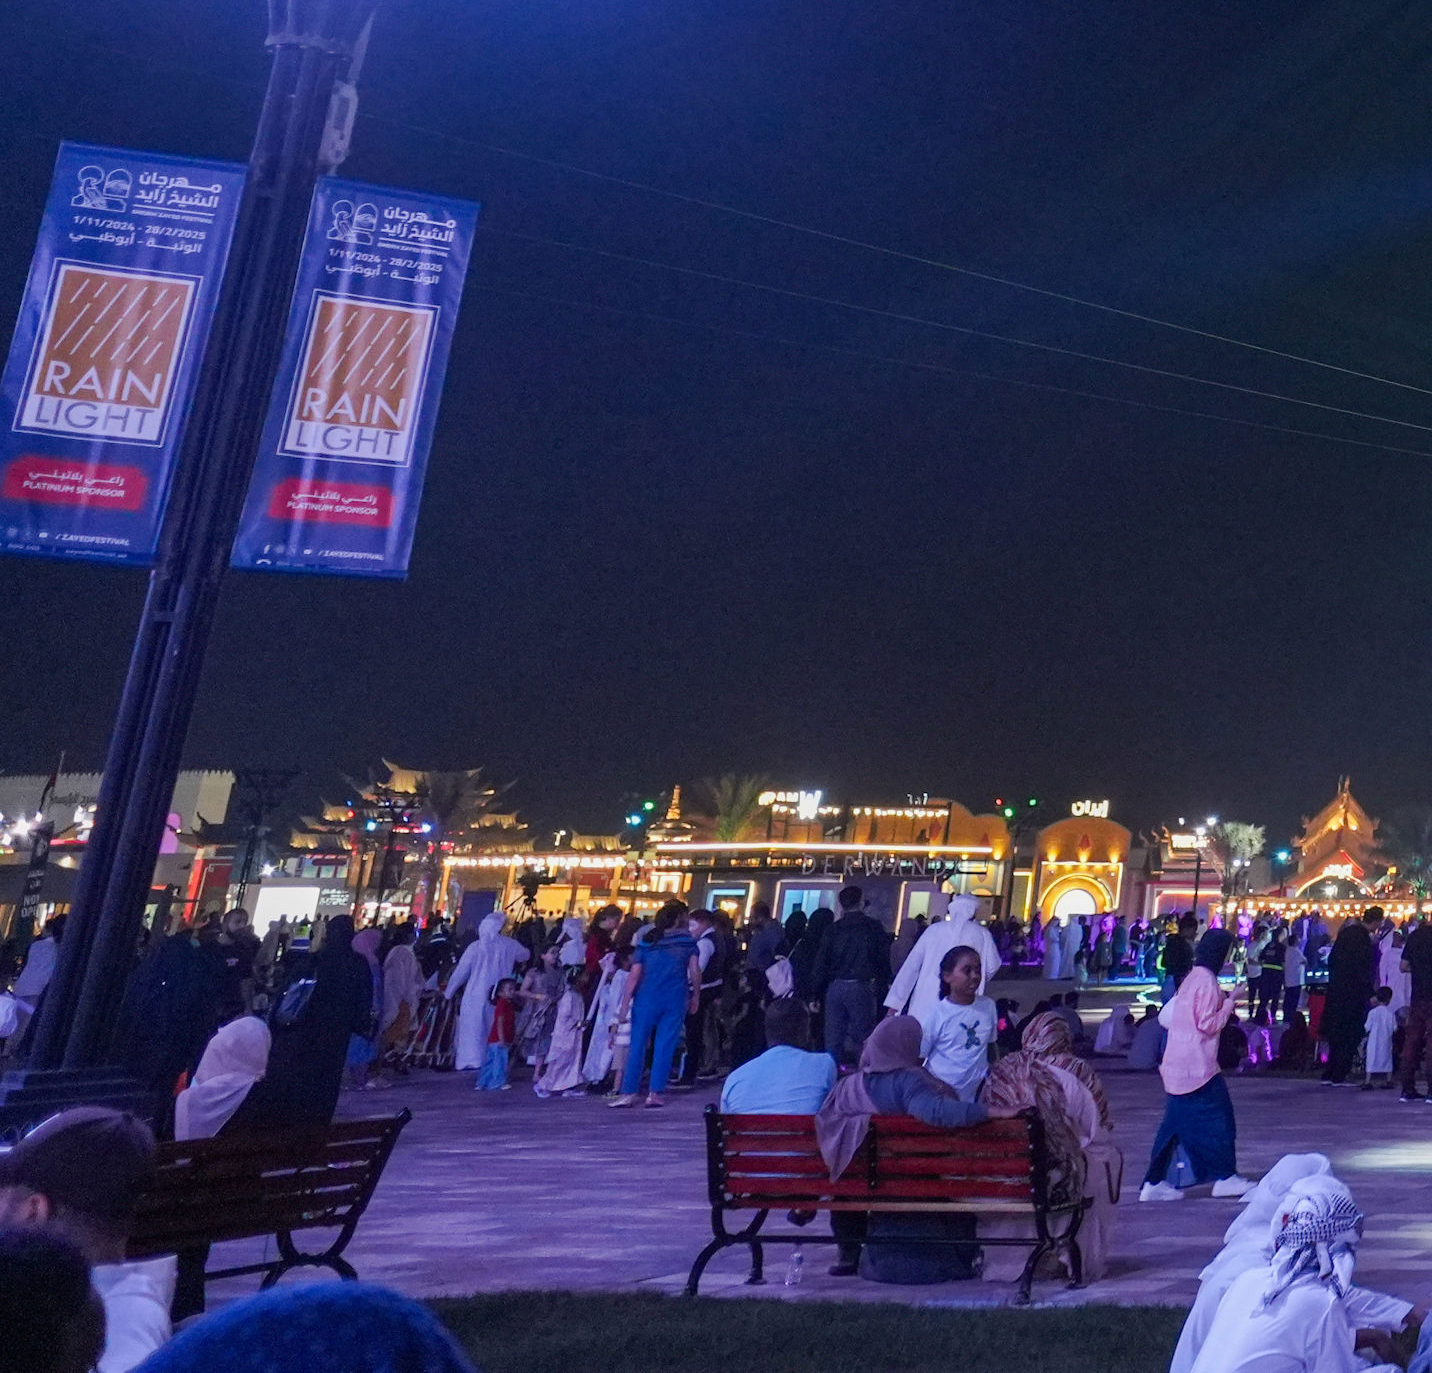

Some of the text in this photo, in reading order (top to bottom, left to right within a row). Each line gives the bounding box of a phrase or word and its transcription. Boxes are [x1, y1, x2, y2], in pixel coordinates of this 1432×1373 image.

[139, 171, 222, 194] مهرجان
[135, 188, 220, 208] الشيخ زايد
[73, 215, 135, 231] 1/11/2024
[145, 225, 207, 240] 28/2/2025
[384, 206, 457, 228] مهرجان
[381, 222, 455, 242] الشيخ زايد
[329, 248, 381, 264] 1/11/2024
[389, 257, 443, 272] 28/2/2025
[43, 360, 163, 404] RAIN
[35, 397, 155, 434] LIGHT
[302, 387, 407, 427] RAIN
[23, 480, 126, 498] PLATINUM SPONSOR
[287, 501, 378, 515] PLATINUM SPONSOR
